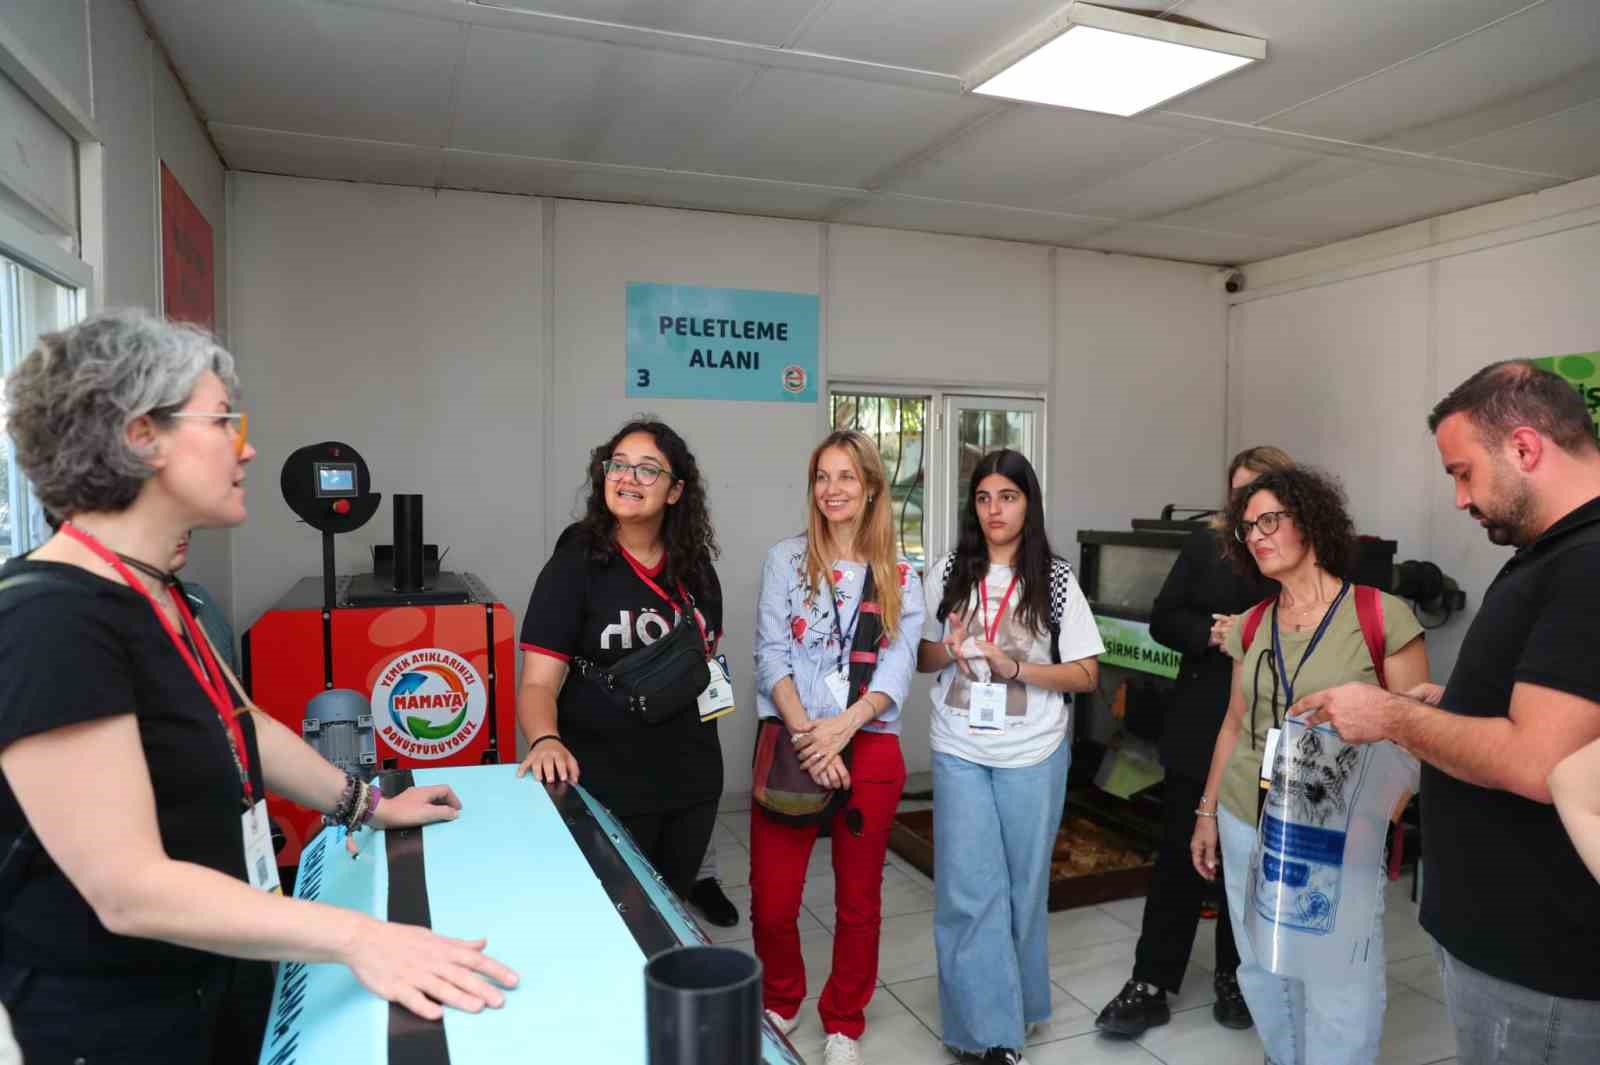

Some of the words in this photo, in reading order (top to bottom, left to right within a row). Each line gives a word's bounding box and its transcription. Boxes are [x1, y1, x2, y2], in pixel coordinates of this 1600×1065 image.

[659, 315, 788, 341] PELETLEME
[689, 349, 760, 370] ALANI
[637, 369, 650, 387] 3
[380, 658, 411, 687] YEMEK
[412, 652, 476, 685] ATIKLARINIZI
[394, 692, 464, 710] MAMAYA
